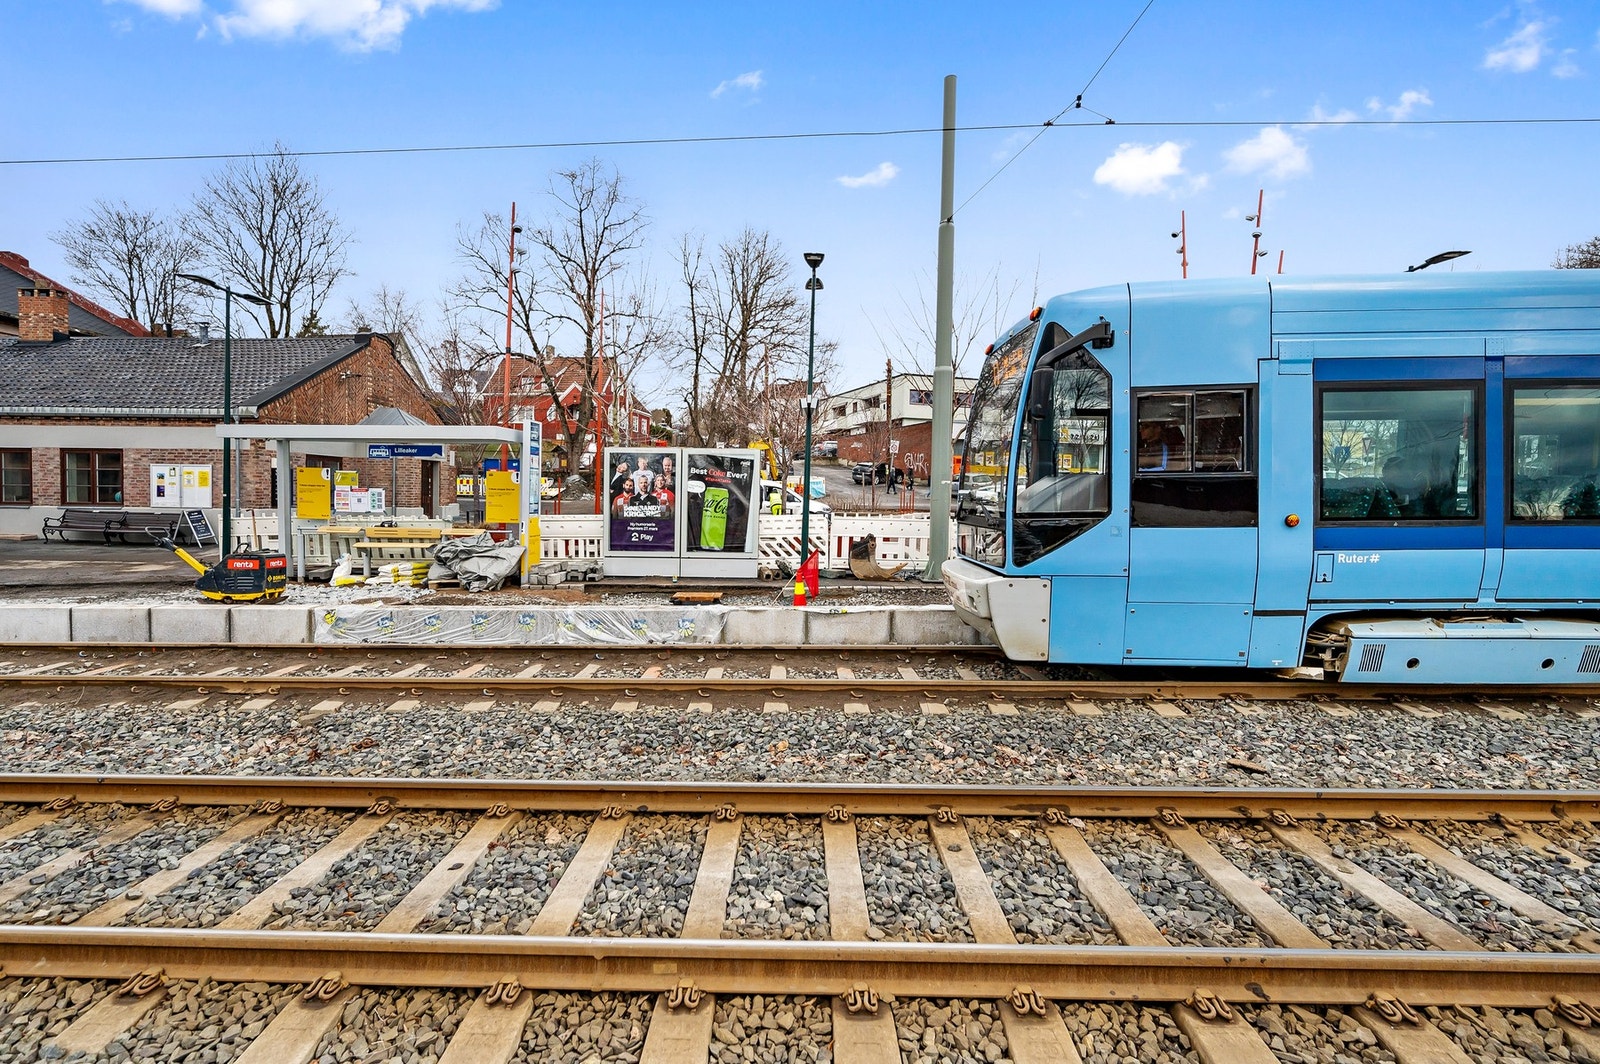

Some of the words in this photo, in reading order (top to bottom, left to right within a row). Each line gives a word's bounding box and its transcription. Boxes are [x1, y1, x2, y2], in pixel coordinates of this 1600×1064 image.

[691, 467, 707, 475] Best
[708, 469, 726, 477] Coke
[727, 471, 748, 479] Ever?
[631, 532, 639, 541] 2
[640, 534, 653, 542] Play
[1338, 553, 1380, 563] Ruter#
